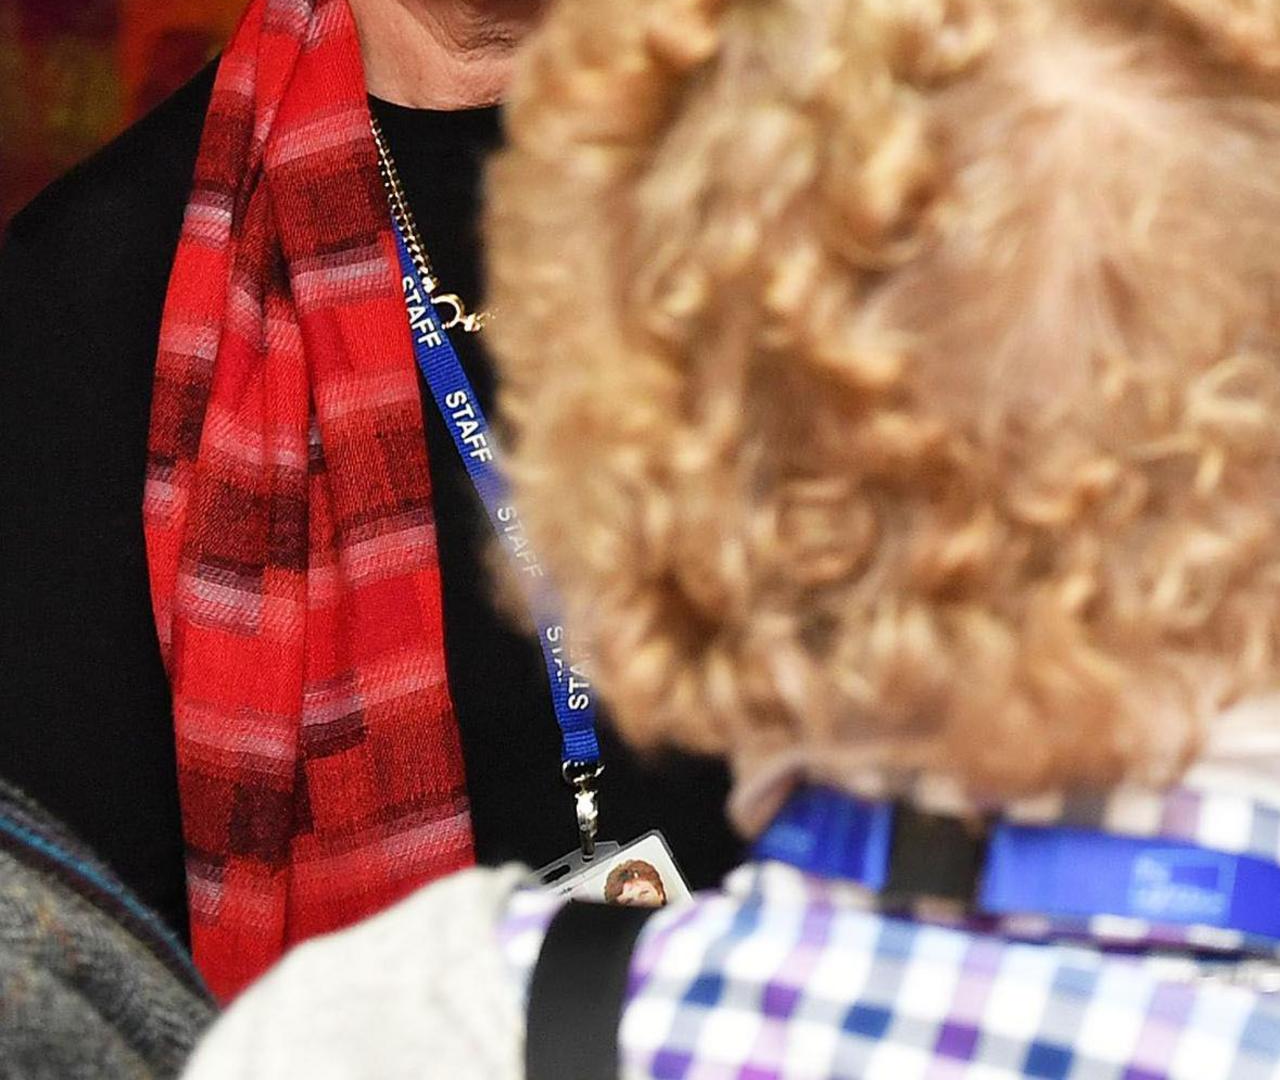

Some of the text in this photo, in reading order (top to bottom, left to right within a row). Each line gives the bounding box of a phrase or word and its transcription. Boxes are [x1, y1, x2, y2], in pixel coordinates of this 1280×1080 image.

[402, 276, 442, 349] STAFF
[445, 390, 493, 463] STAFF
[497, 505, 544, 578] STAFF
[568, 644, 591, 711] STA
